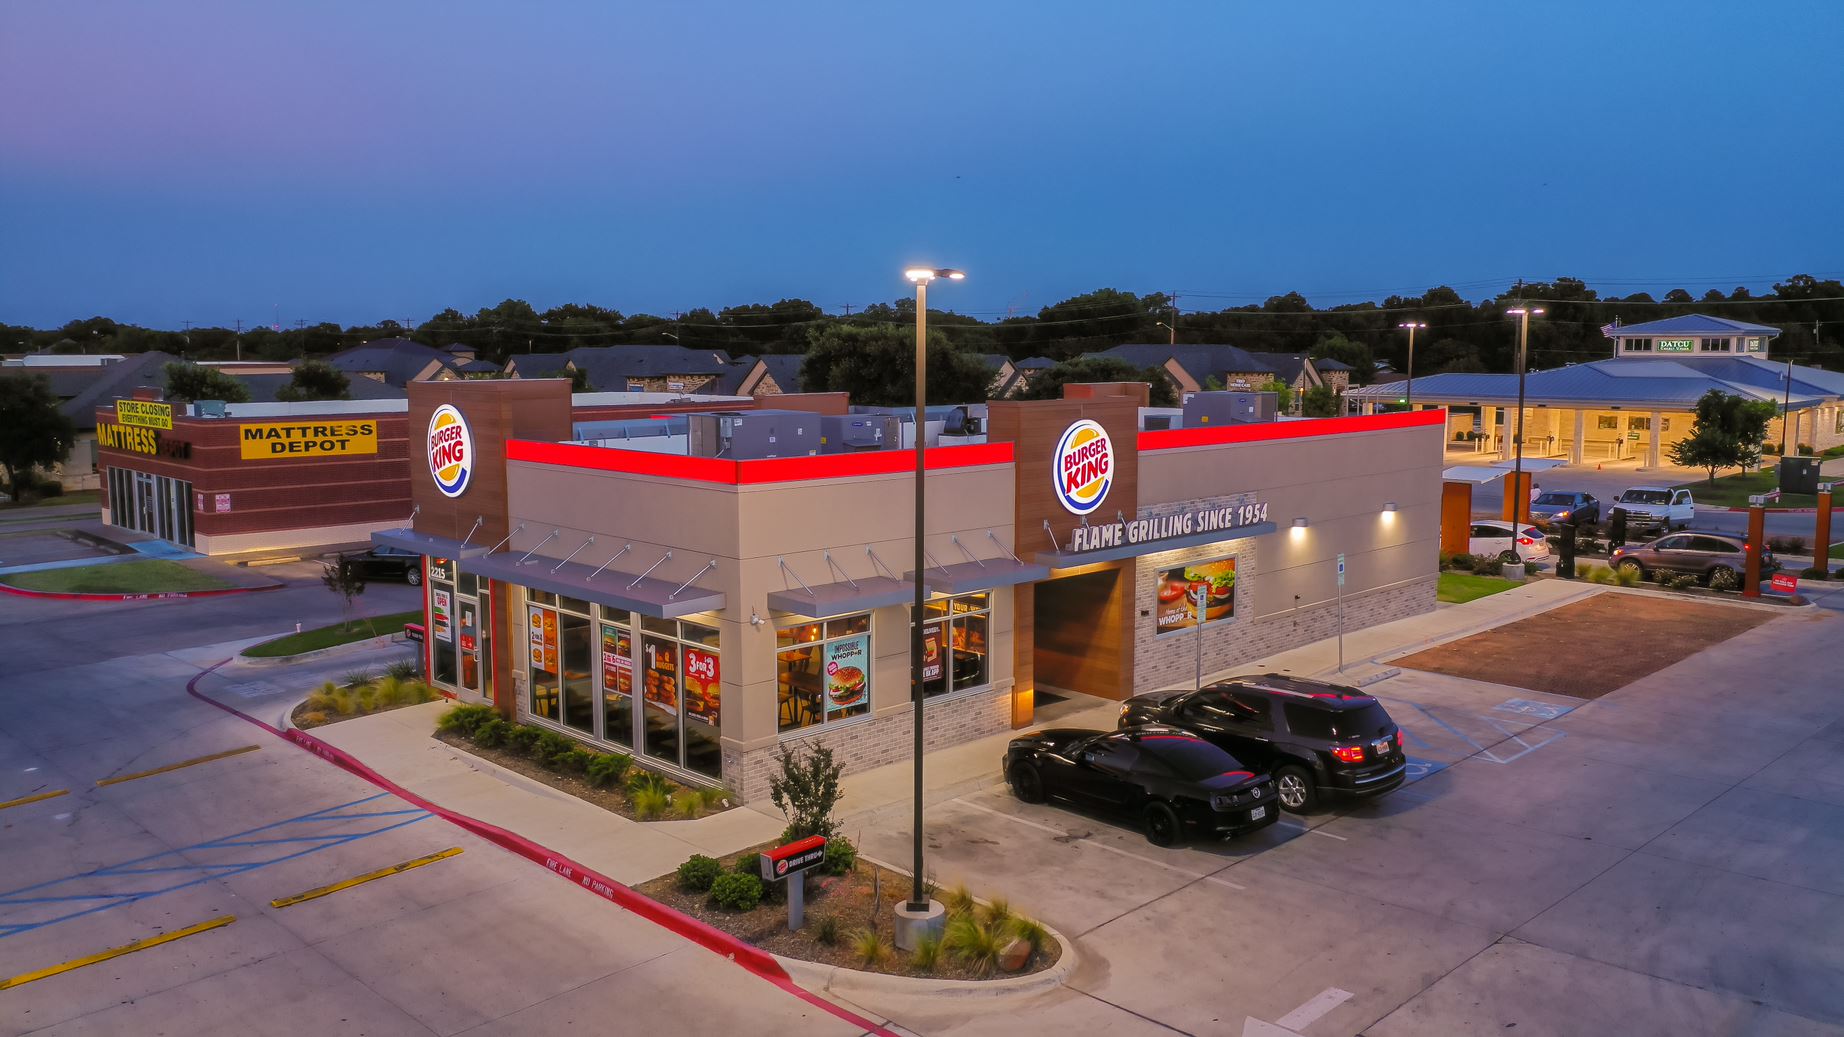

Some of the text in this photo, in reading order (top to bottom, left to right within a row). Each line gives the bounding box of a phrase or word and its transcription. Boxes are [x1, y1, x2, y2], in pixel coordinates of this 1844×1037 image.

[1660, 340, 1690, 348] DATCU
[119, 402, 171, 417] STORE CLOSING
[122, 414, 168, 427] EVERYTHING MUST GO
[97, 423, 157, 455] MATTRESS
[243, 424, 374, 441] MATTRESS
[431, 425, 462, 451] BURGER
[270, 439, 351, 454] DEPOT
[1064, 437, 1107, 473] BURGER
[432, 440, 464, 474] KING
[1065, 452, 1109, 495] KING
[1073, 502, 1268, 552] FLAME GRILLING SINCE 1954
[430, 566, 446, 579] 2215
[953, 602, 968, 612] YOUR
[1158, 611, 1193, 626] WHOPPR
[688, 652, 697, 673] 3
[696, 660, 706, 672] FOR
[788, 856, 804, 868] DRIVE
[804, 851, 818, 862] THRU
[546, 857, 614, 900] FIRE LANE NO PARKING
